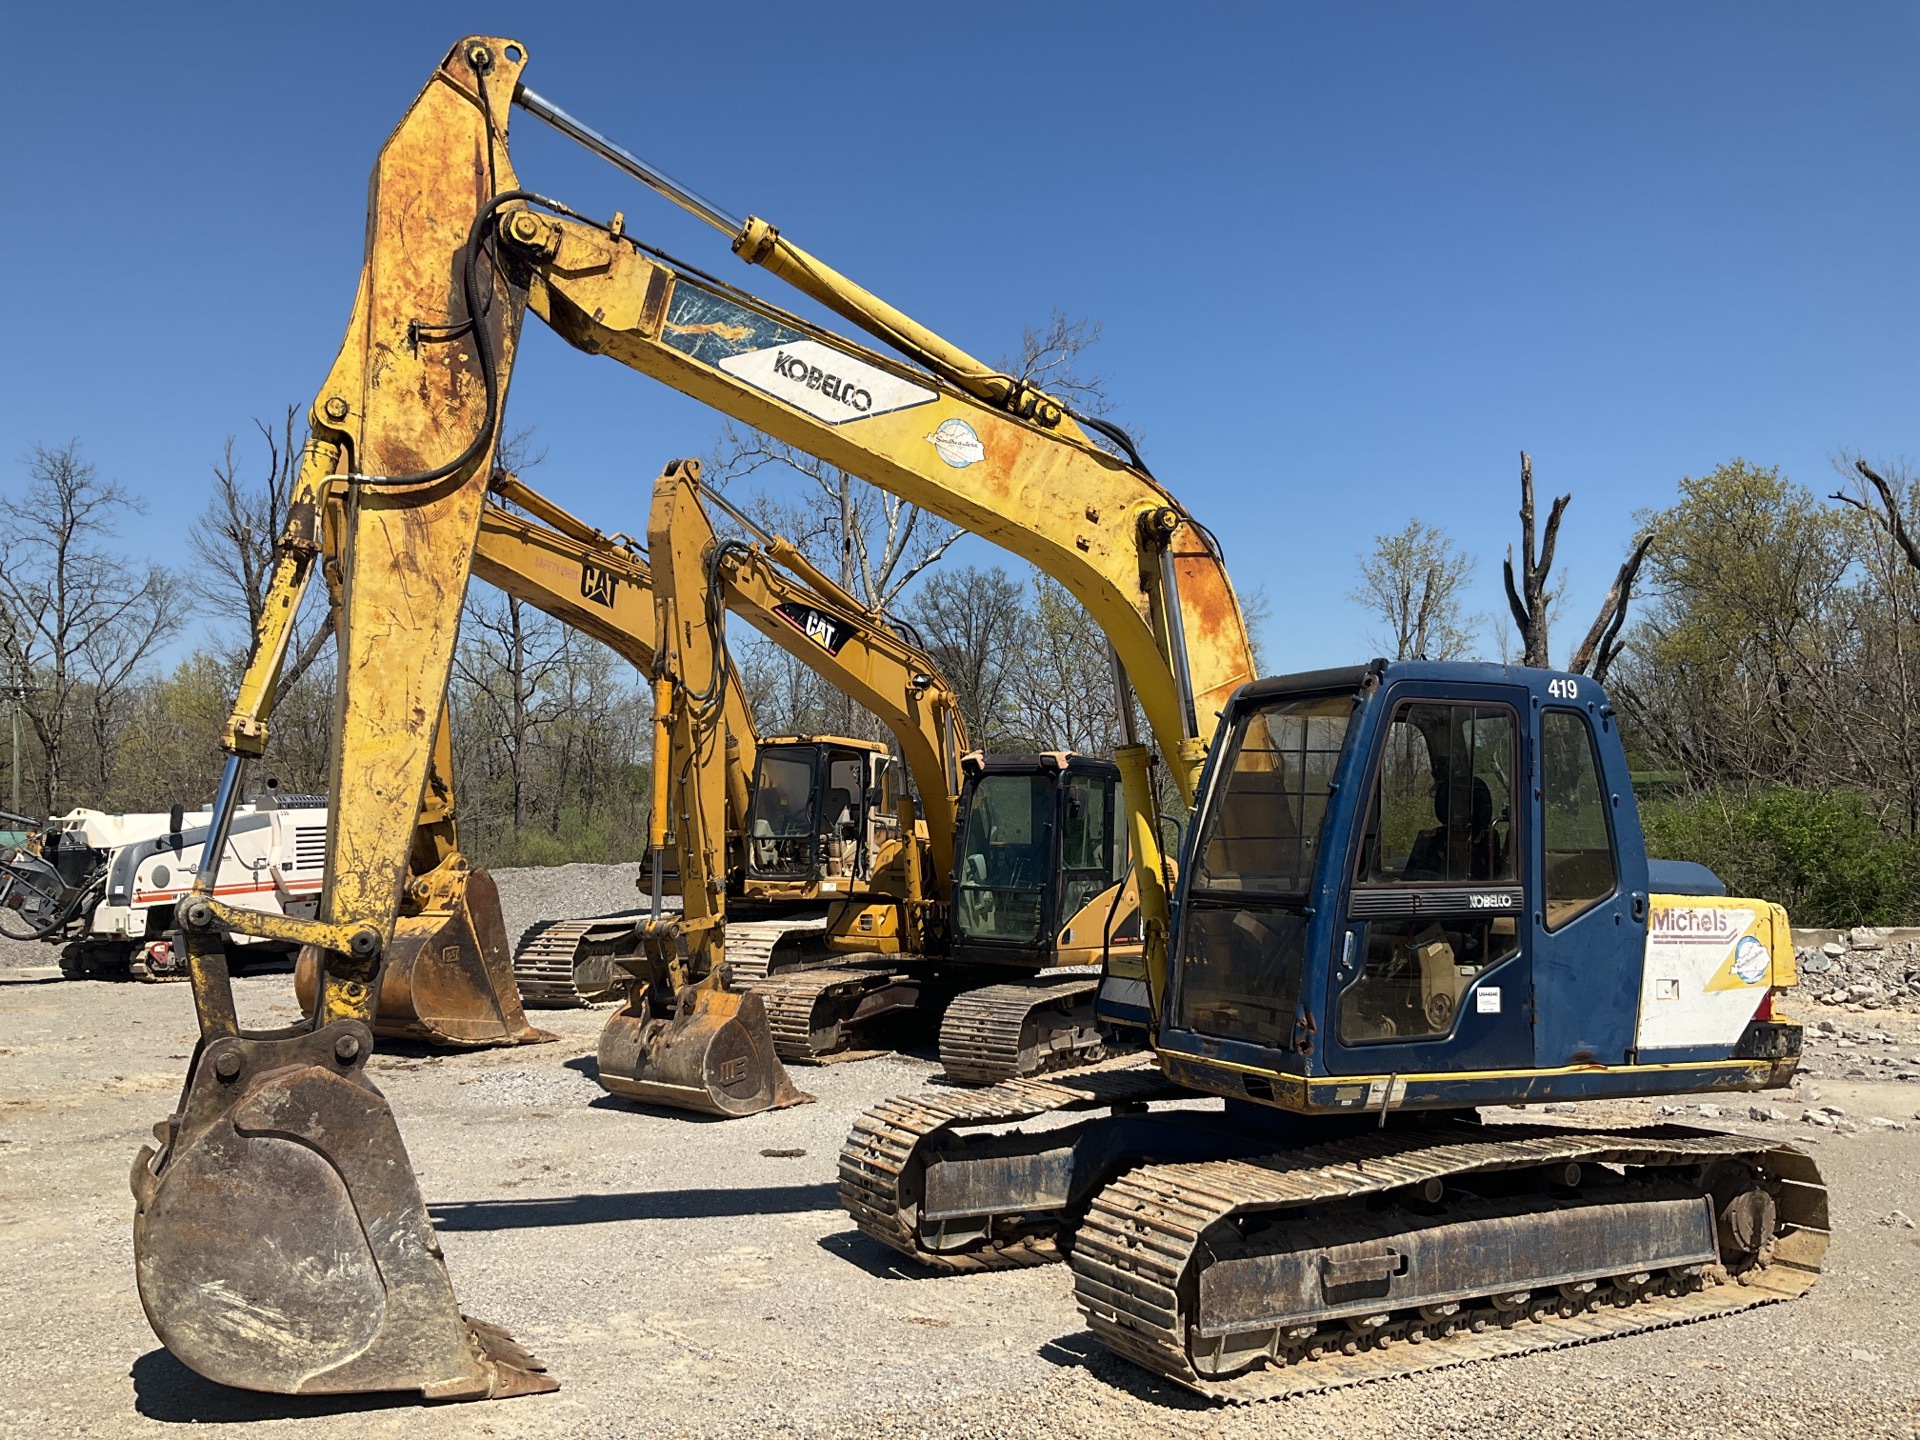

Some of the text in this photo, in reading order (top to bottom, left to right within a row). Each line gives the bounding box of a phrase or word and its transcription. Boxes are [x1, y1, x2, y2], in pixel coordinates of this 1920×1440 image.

[773, 350, 872, 412] KOBELCO
[581, 565, 620, 609] CAT
[806, 610, 836, 650] CAT
[1548, 679, 1578, 699] 419
[1469, 894, 1512, 909] KOBELCO
[1652, 908, 1727, 932] Michels
